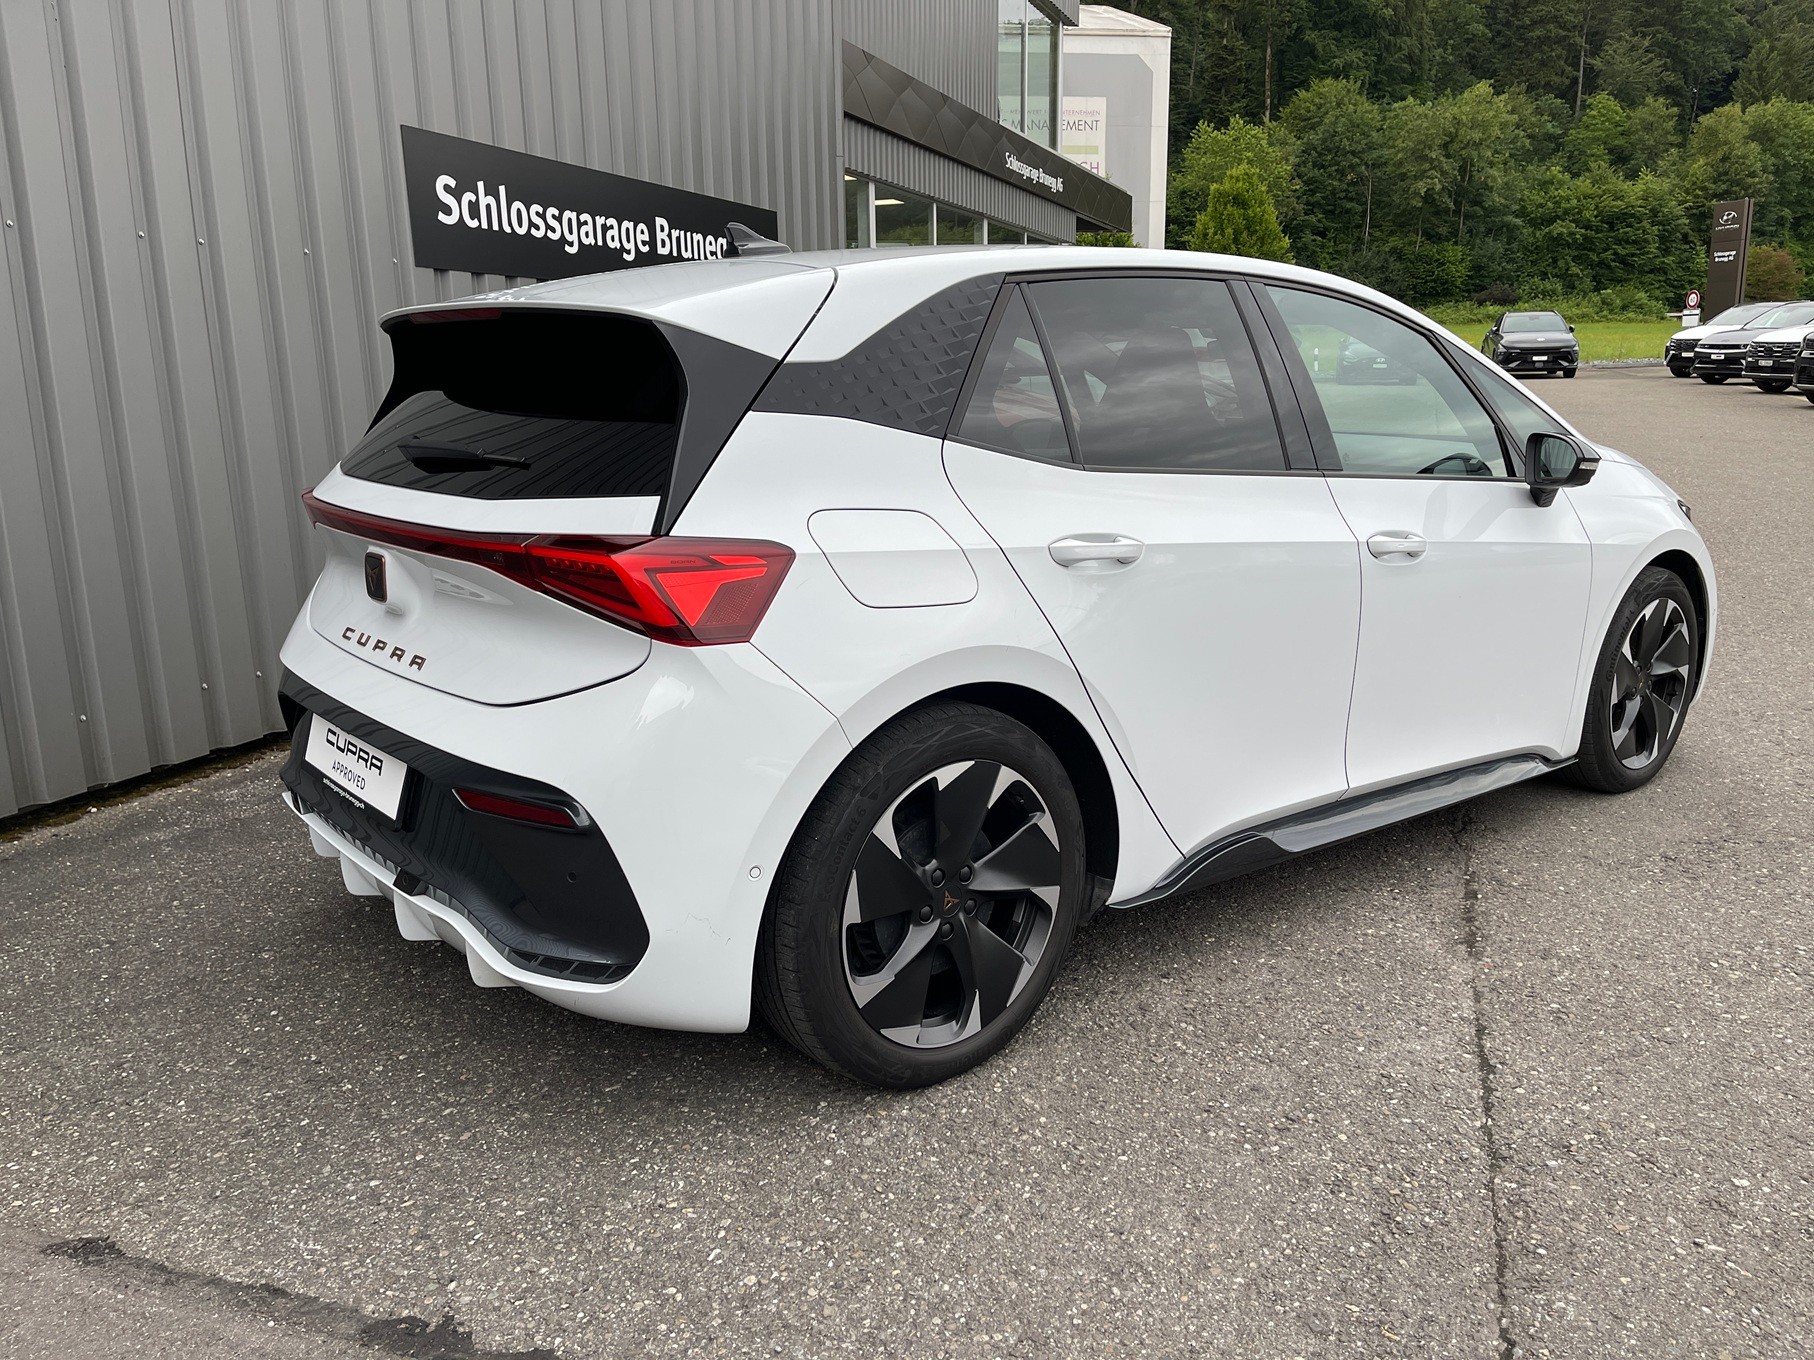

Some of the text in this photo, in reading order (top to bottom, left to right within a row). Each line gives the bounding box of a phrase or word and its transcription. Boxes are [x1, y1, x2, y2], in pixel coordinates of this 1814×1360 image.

[1005, 152, 1039, 184] Schlossgarage
[1039, 168, 1056, 192] Brunegg
[435, 174, 649, 261] Schlossgarage
[342, 626, 427, 671] CUPRA
[326, 728, 383, 776] CUPRA
[332, 760, 366, 790] APPROVED
